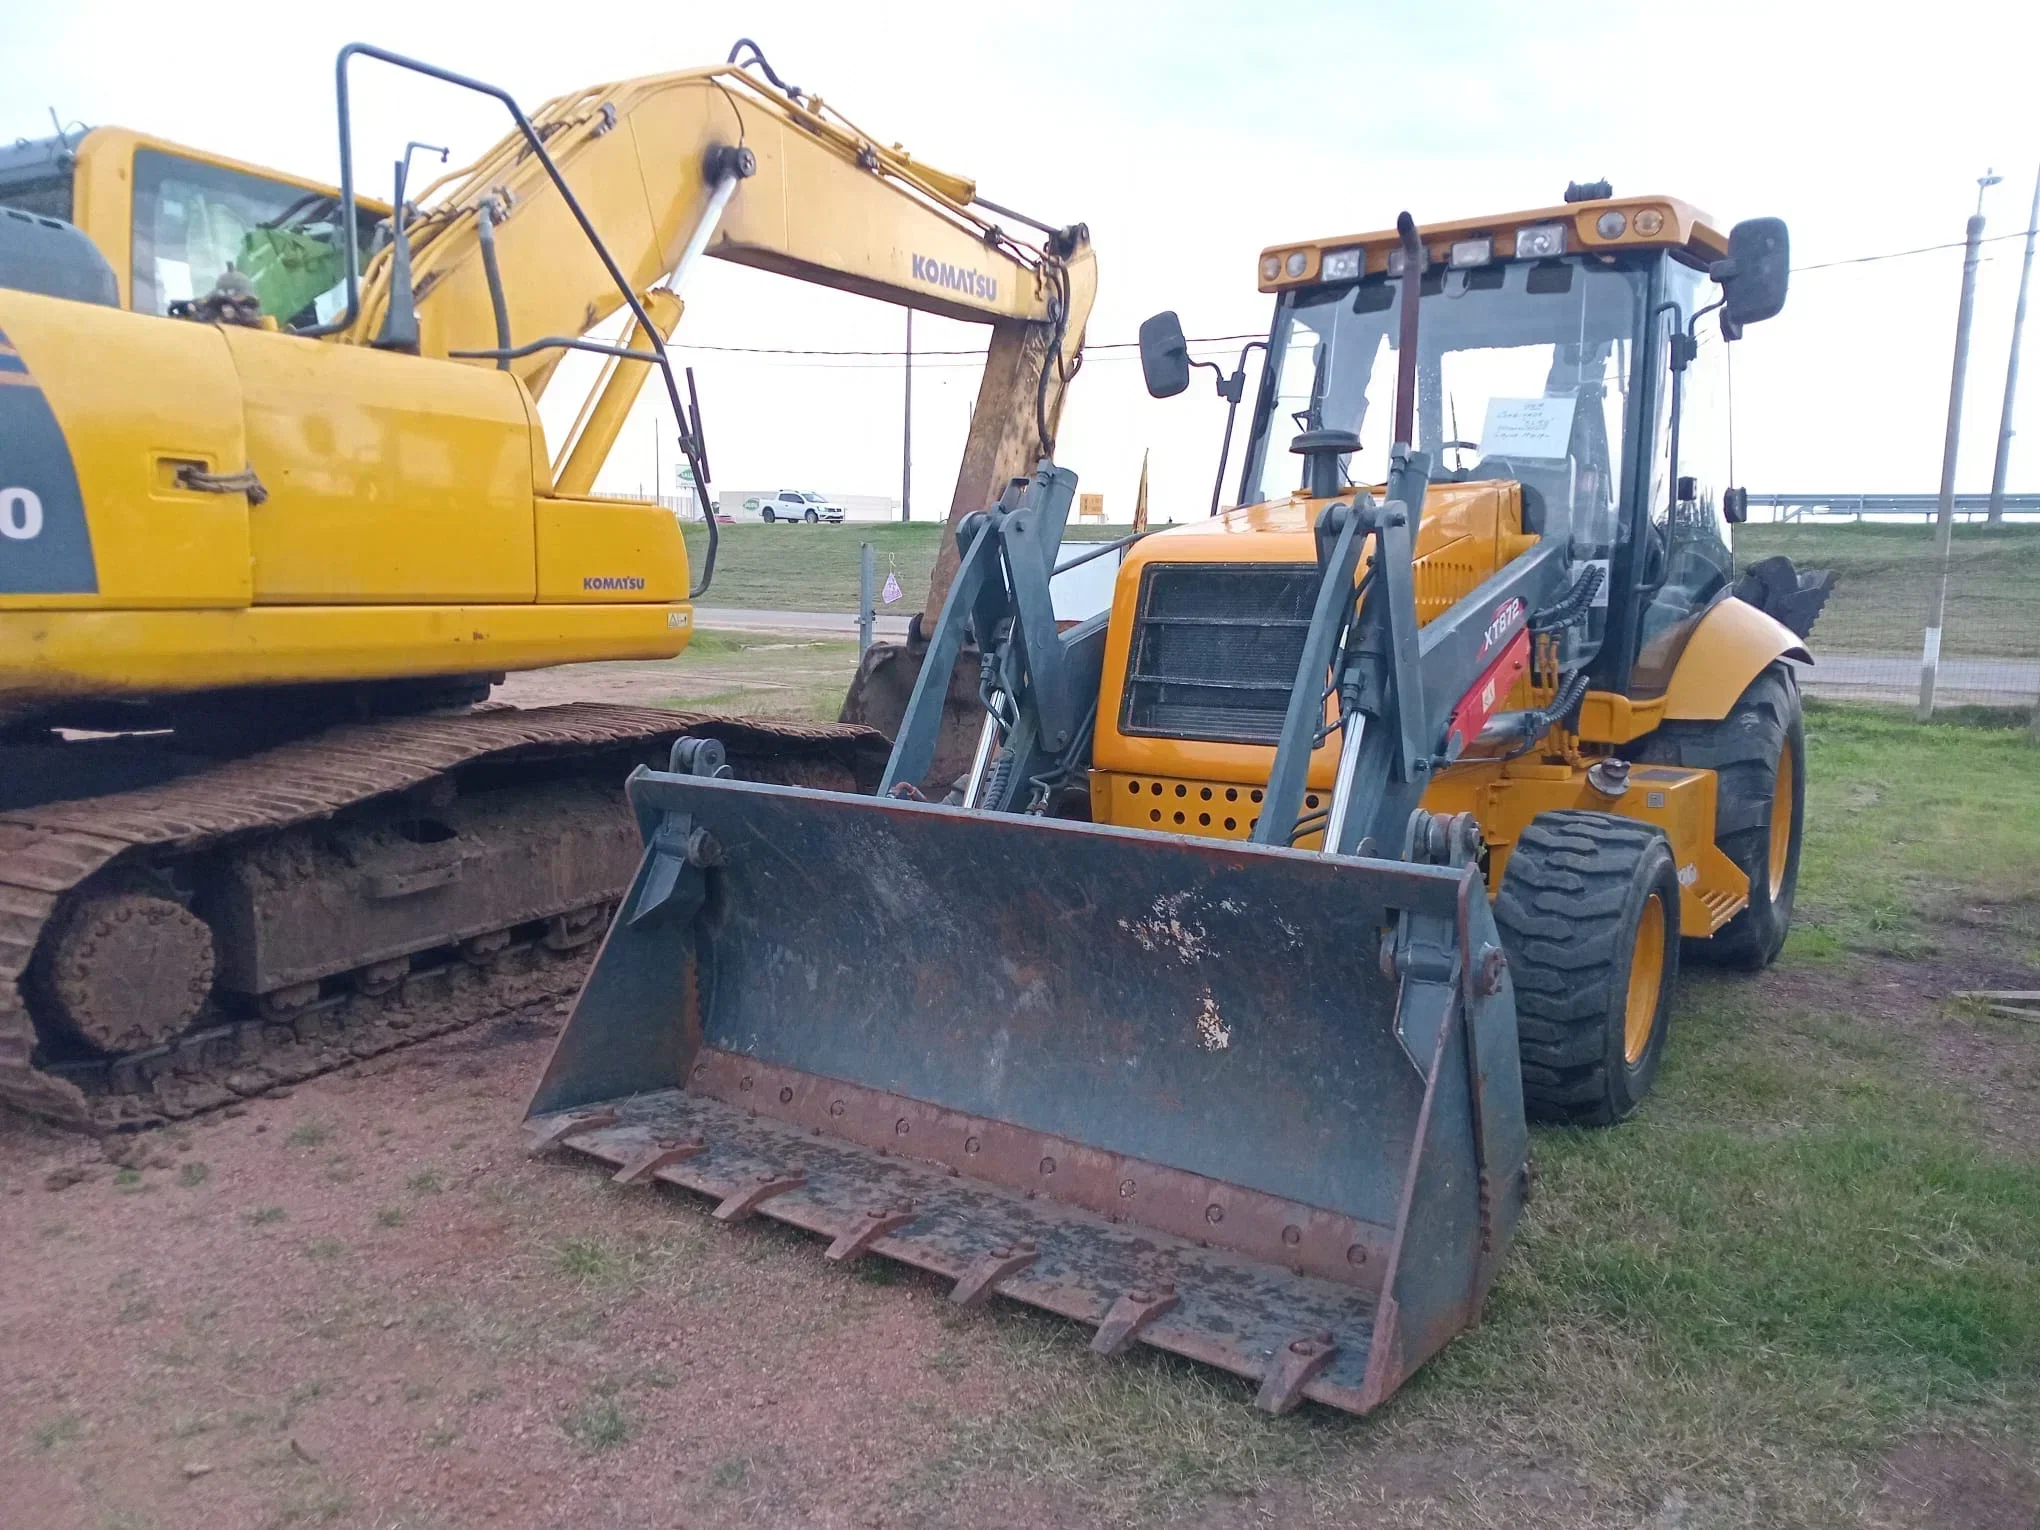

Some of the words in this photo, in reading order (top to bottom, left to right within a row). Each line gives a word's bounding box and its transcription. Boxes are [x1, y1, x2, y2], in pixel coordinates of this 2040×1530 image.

[912, 252, 997, 302] KOMATSU
[583, 576, 645, 590] KOMATSU
[1484, 598, 1520, 651] XT872
